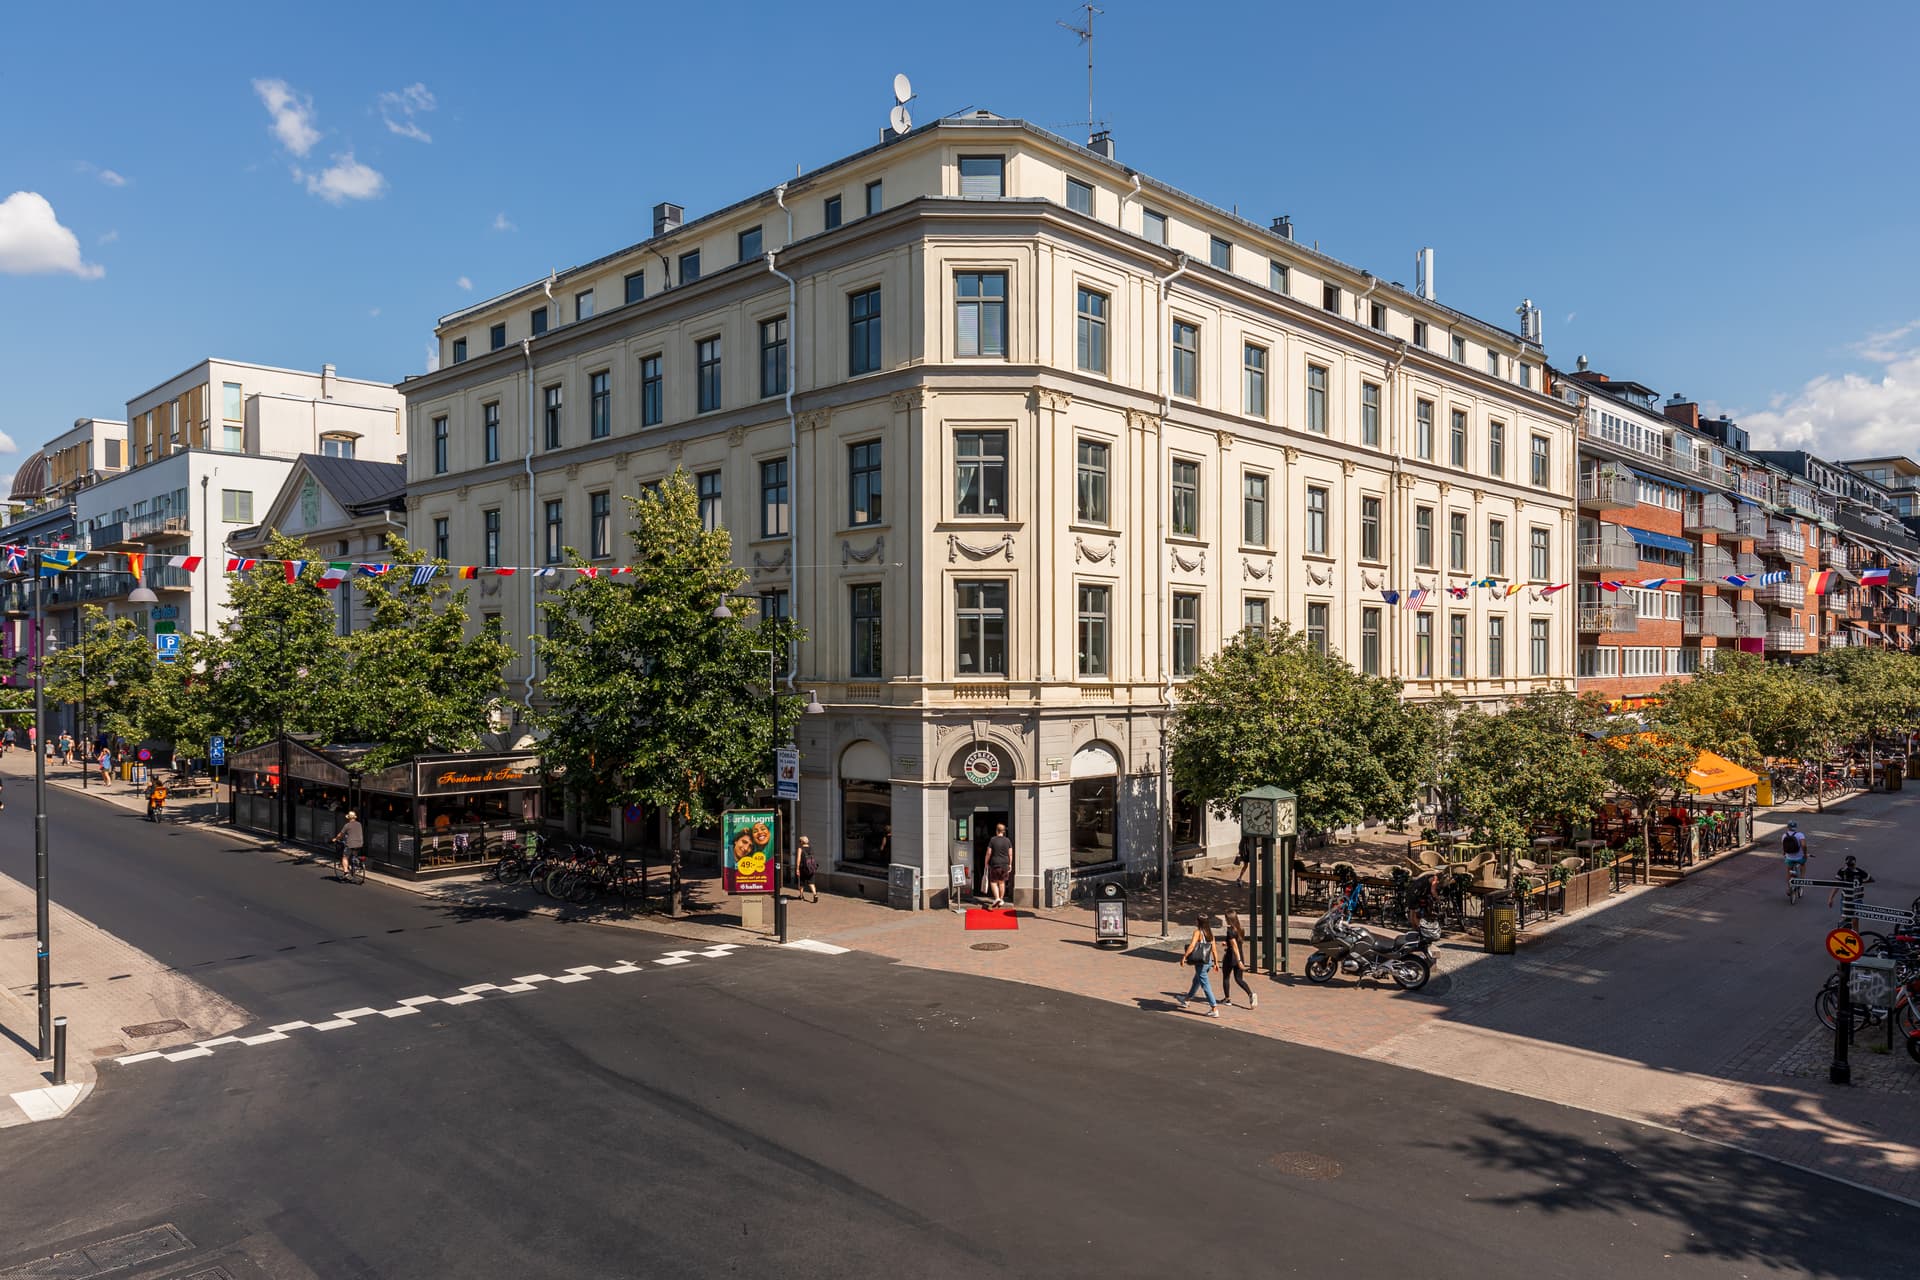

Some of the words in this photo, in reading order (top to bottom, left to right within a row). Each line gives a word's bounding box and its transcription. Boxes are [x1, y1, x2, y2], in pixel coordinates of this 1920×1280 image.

[167, 639, 175, 649] P
[967, 752, 997, 767] ESPRESSO
[438, 771, 481, 784] Fontana
[483, 768, 492, 781] di
[495, 768, 523, 780] Trevi
[969, 772, 994, 783] HOUSE
[727, 815, 750, 823] Surfa
[751, 815, 774, 824] lugnt
